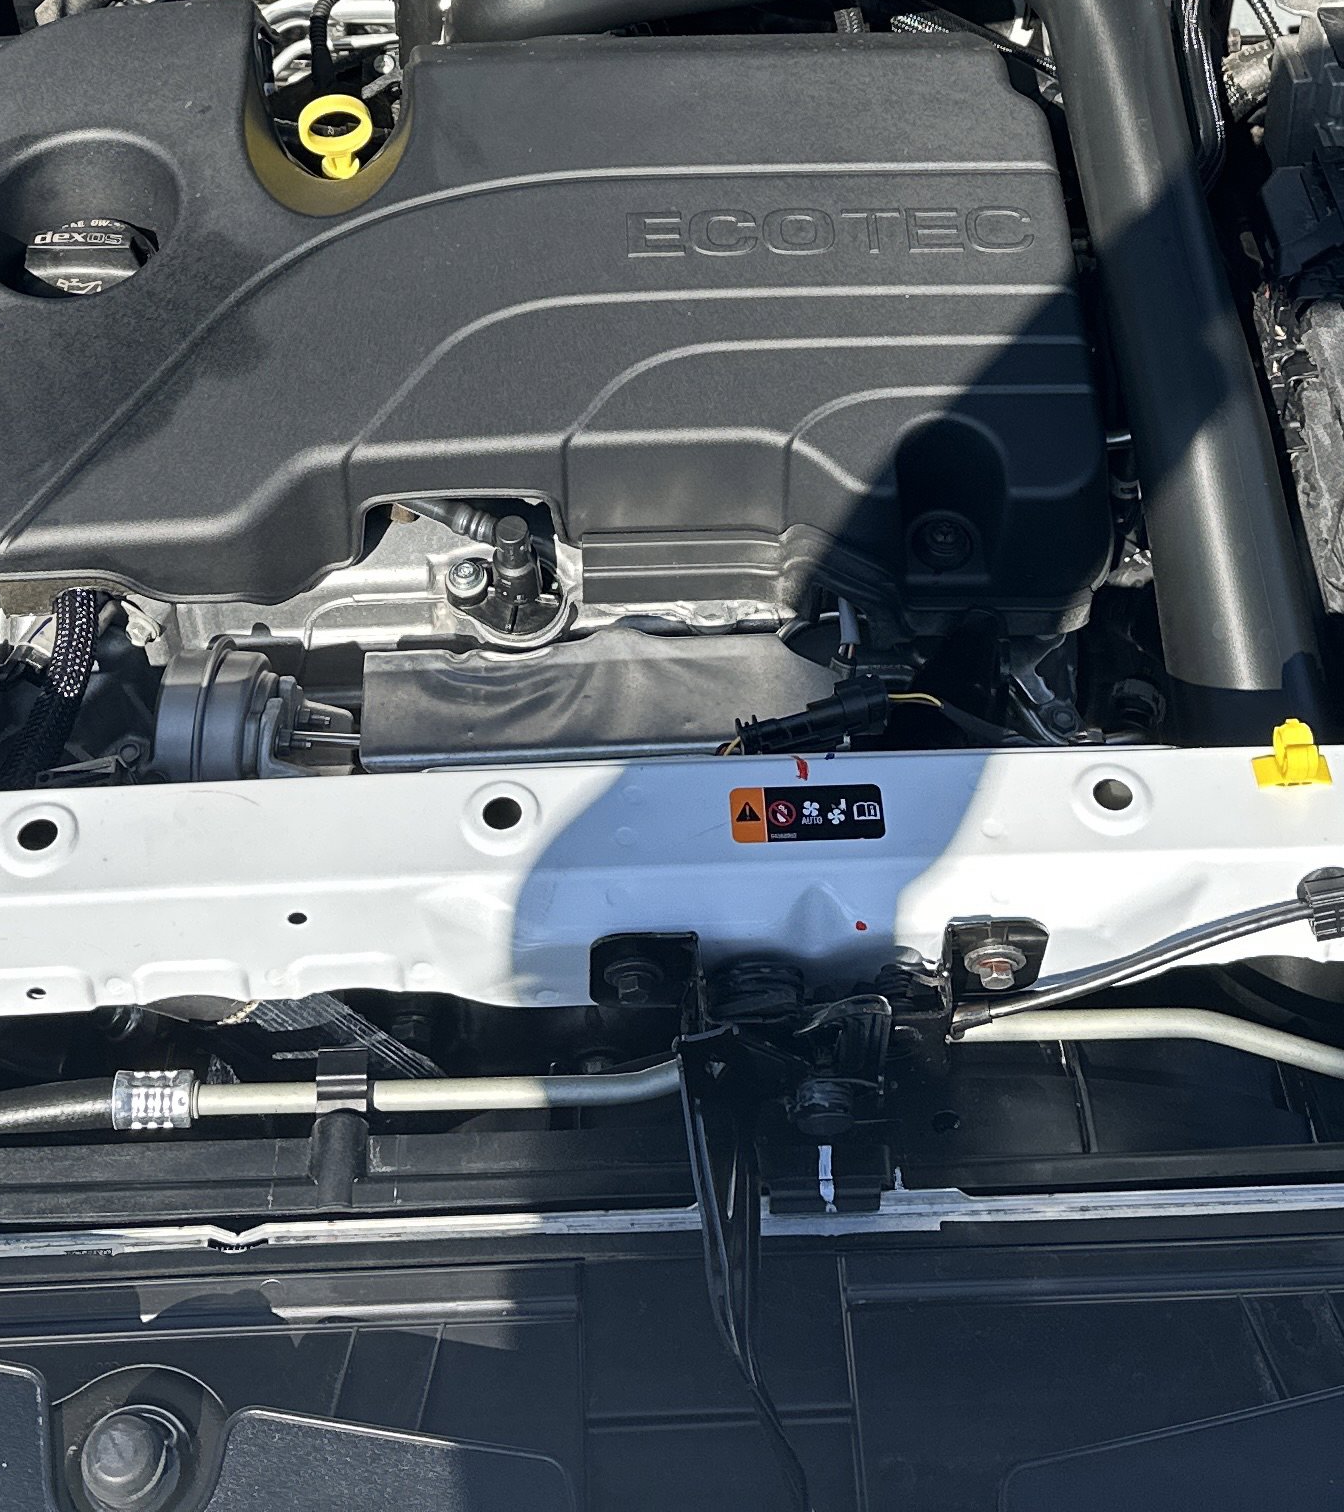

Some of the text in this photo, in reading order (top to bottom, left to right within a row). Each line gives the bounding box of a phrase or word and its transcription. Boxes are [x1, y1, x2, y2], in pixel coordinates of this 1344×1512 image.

[34, 230, 123, 245] dexos
[625, 206, 1035, 258] ECOTEC
[801, 816, 823, 825] AUTO
